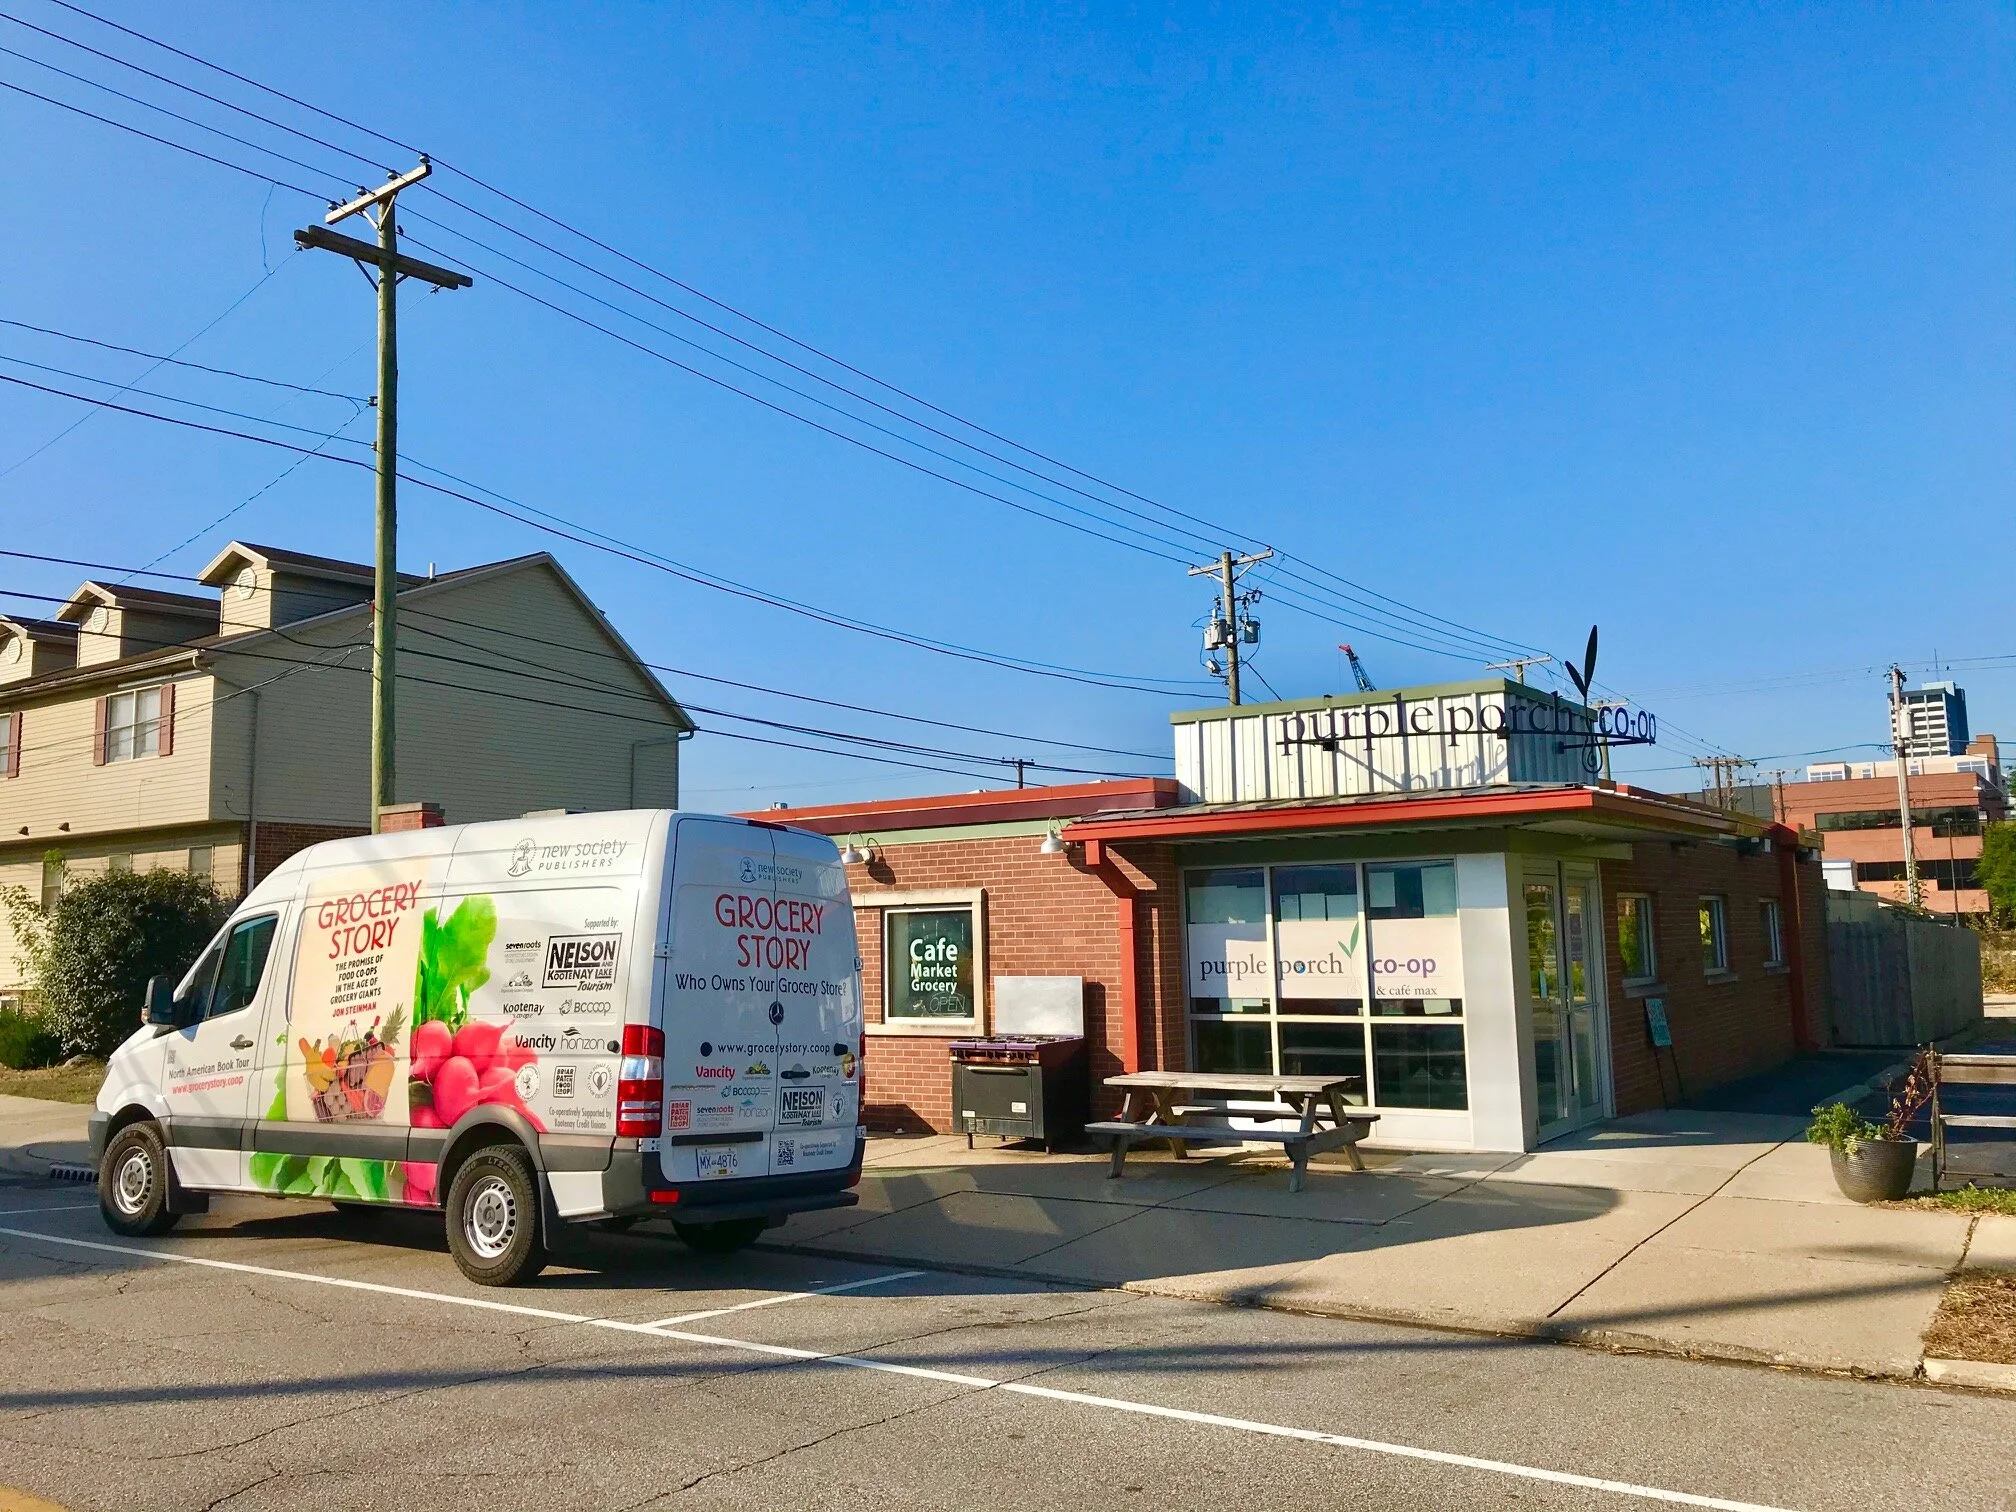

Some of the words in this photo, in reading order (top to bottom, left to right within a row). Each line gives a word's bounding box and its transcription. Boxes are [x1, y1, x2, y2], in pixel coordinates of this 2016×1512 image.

[1279, 692, 1434, 756] purple
[1446, 690, 1577, 747] porch
[1599, 706, 1657, 745] co-op
[541, 846, 572, 858] new
[574, 839, 628, 857] society
[538, 858, 613, 871] PUBLISHERS
[758, 864, 774, 873] new
[776, 866, 803, 879] society
[758, 874, 799, 884] PUBLISHERS
[318, 879, 422, 929] GROCERY
[715, 893, 823, 935] GROCERY
[584, 917, 609, 929] Supported
[610, 916, 619, 928] by:
[328, 917, 400, 959] STORY
[549, 941, 616, 970] NELSON
[737, 934, 811, 971] STORY
[909, 937, 958, 961] Cafe
[335, 961, 347, 972] THE
[348, 957, 374, 969] PROMISE
[375, 954, 384, 964] OF
[910, 962, 958, 977] Market
[1200, 953, 1267, 981] purple
[1279, 952, 1344, 981] porch
[1372, 957, 1436, 978] co-op
[338, 971, 354, 982] FOOD
[356, 966, 377, 978] CO-OPS
[595, 968, 613, 979] LAKE
[335, 984, 342, 993] IN
[343, 981, 355, 991] THE
[356, 979, 368, 989] AGE
[369, 977, 378, 987] OF
[576, 981, 613, 992] Tourism
[675, 974, 706, 991] Who
[711, 974, 745, 991] Owns
[748, 976, 775, 993] Your
[778, 977, 818, 997] Grocery
[820, 980, 847, 996] Store?
[911, 979, 957, 994] Grocery
[1376, 985, 1386, 995] &
[1388, 984, 1411, 996] café
[1414, 986, 1438, 996] max
[330, 992, 357, 1005] GROCERY
[358, 987, 382, 1000] GIANTS
[929, 996, 966, 1012] OPEN
[332, 1007, 344, 1018] JON
[345, 1002, 377, 1015] STEINMAN
[503, 1002, 545, 1016] Kootenay
[515, 1034, 556, 1051] Vancity
[561, 1034, 604, 1050] horizon
[717, 1042, 830, 1057] www.grocerystory.coop
[168, 1068, 185, 1080] North
[186, 1064, 215, 1077] American
[217, 1060, 234, 1072] Book
[235, 1058, 250, 1068] Tour
[695, 1065, 736, 1081] Vancity
[812, 1065, 840, 1076] Kootenay
[172, 1075, 244, 1094] www.grocerystory.coop
[782, 1090, 823, 1110] NELSON
[548, 1106, 581, 1117] Co-operatively
[581, 1107, 605, 1118] Supported
[606, 1108, 612, 1119] by
[554, 1119, 575, 1129] Kootenay
[576, 1119, 590, 1128] Credit
[590, 1121, 606, 1129] Unions
[699, 1156, 711, 1169] MX
[717, 1154, 738, 1168] 4876
